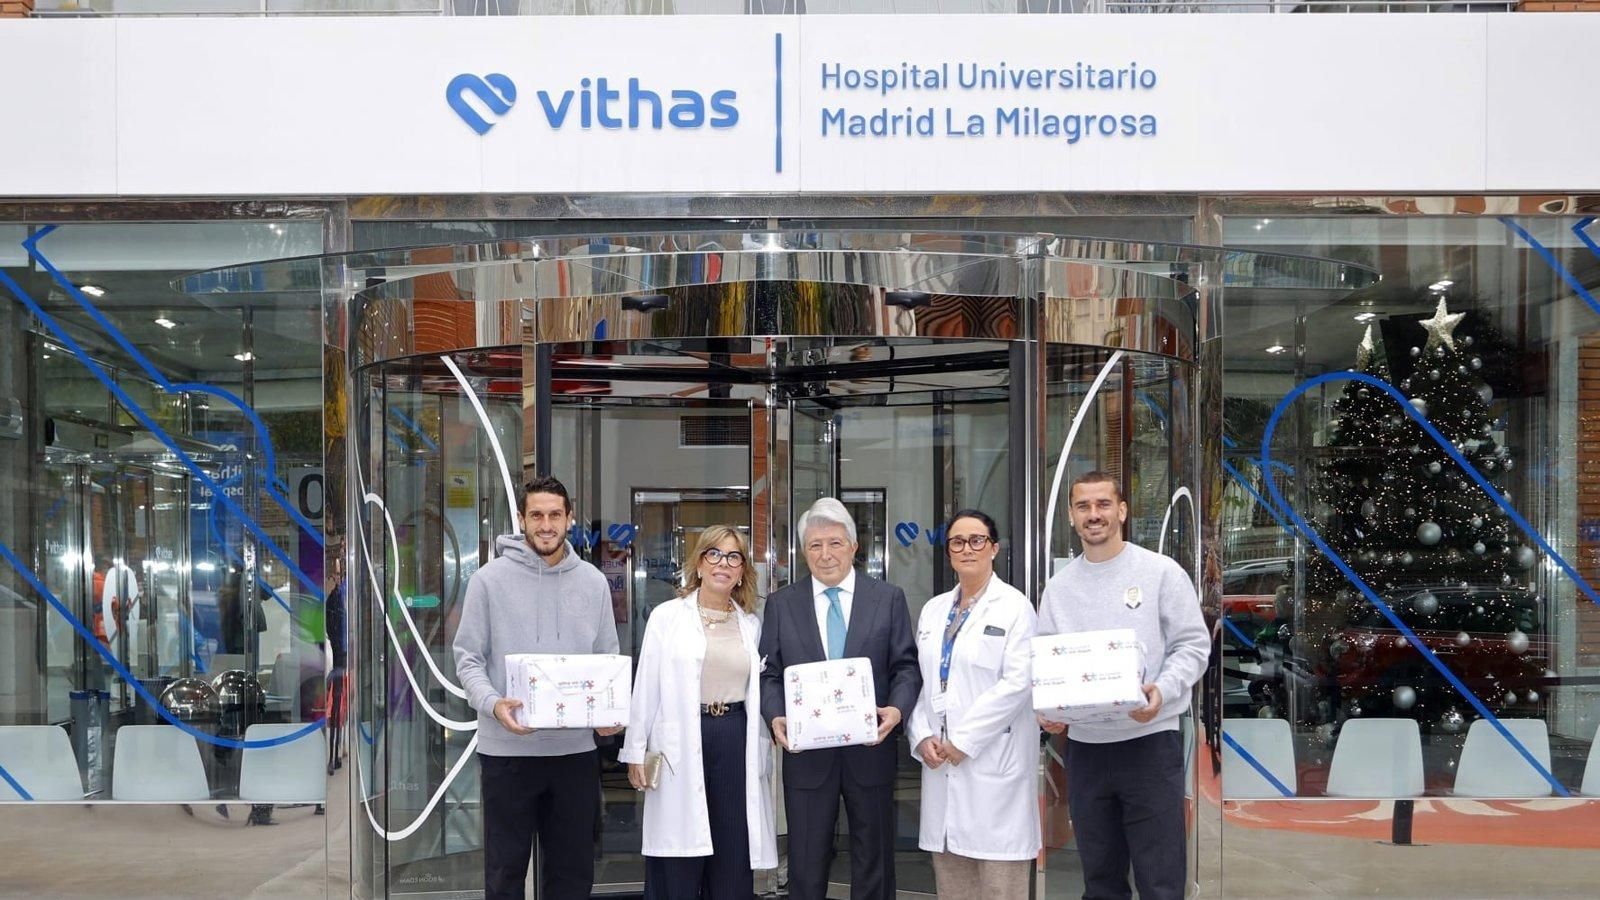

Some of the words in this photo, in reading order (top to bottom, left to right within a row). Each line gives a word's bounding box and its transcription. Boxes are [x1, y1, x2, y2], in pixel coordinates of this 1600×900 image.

[821, 61, 948, 96] Hospital
[957, 61, 1157, 90] Universitario
[537, 77, 740, 129] vithas
[821, 107, 935, 137] Madrid
[946, 107, 985, 136] La
[996, 107, 1157, 145] Milagrosa
